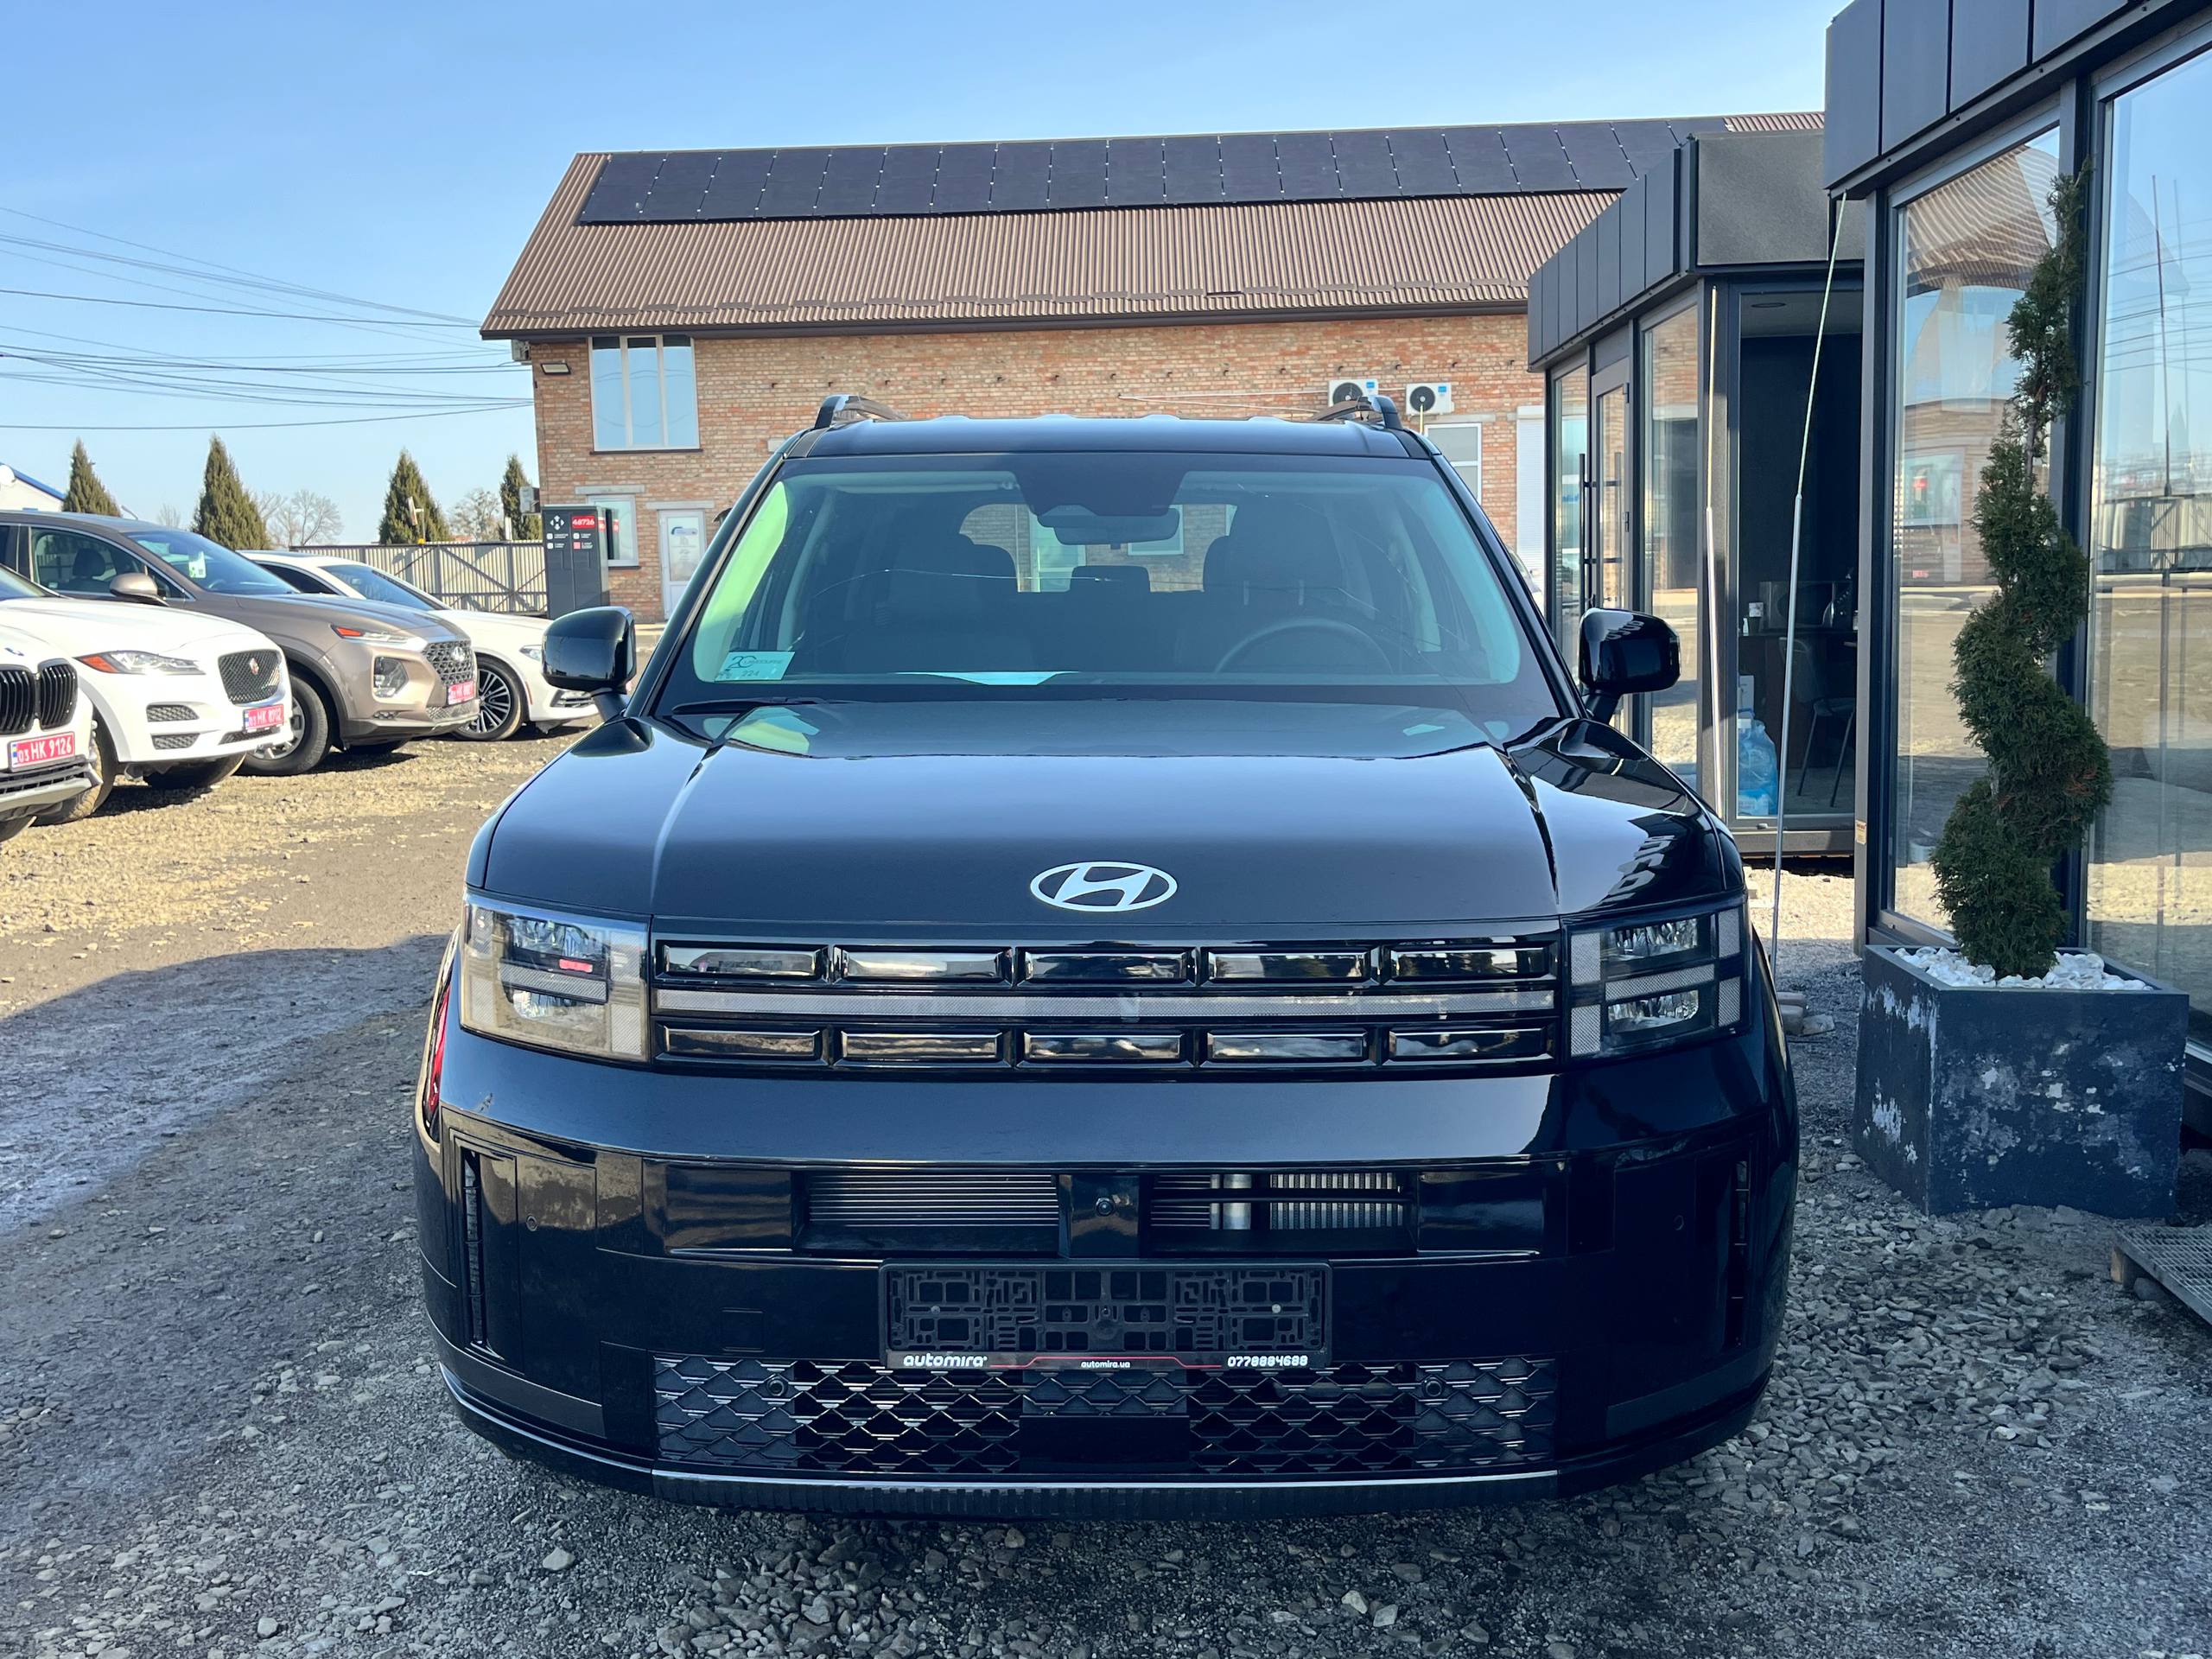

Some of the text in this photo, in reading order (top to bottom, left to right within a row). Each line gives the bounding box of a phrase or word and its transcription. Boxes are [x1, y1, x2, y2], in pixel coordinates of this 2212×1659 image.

[18, 736, 73, 763] 03 HK 9126
[903, 1352, 986, 1368] automira
[1080, 1359, 1131, 1369] automira.ua
[1227, 1355, 1308, 1367] 0778884688
